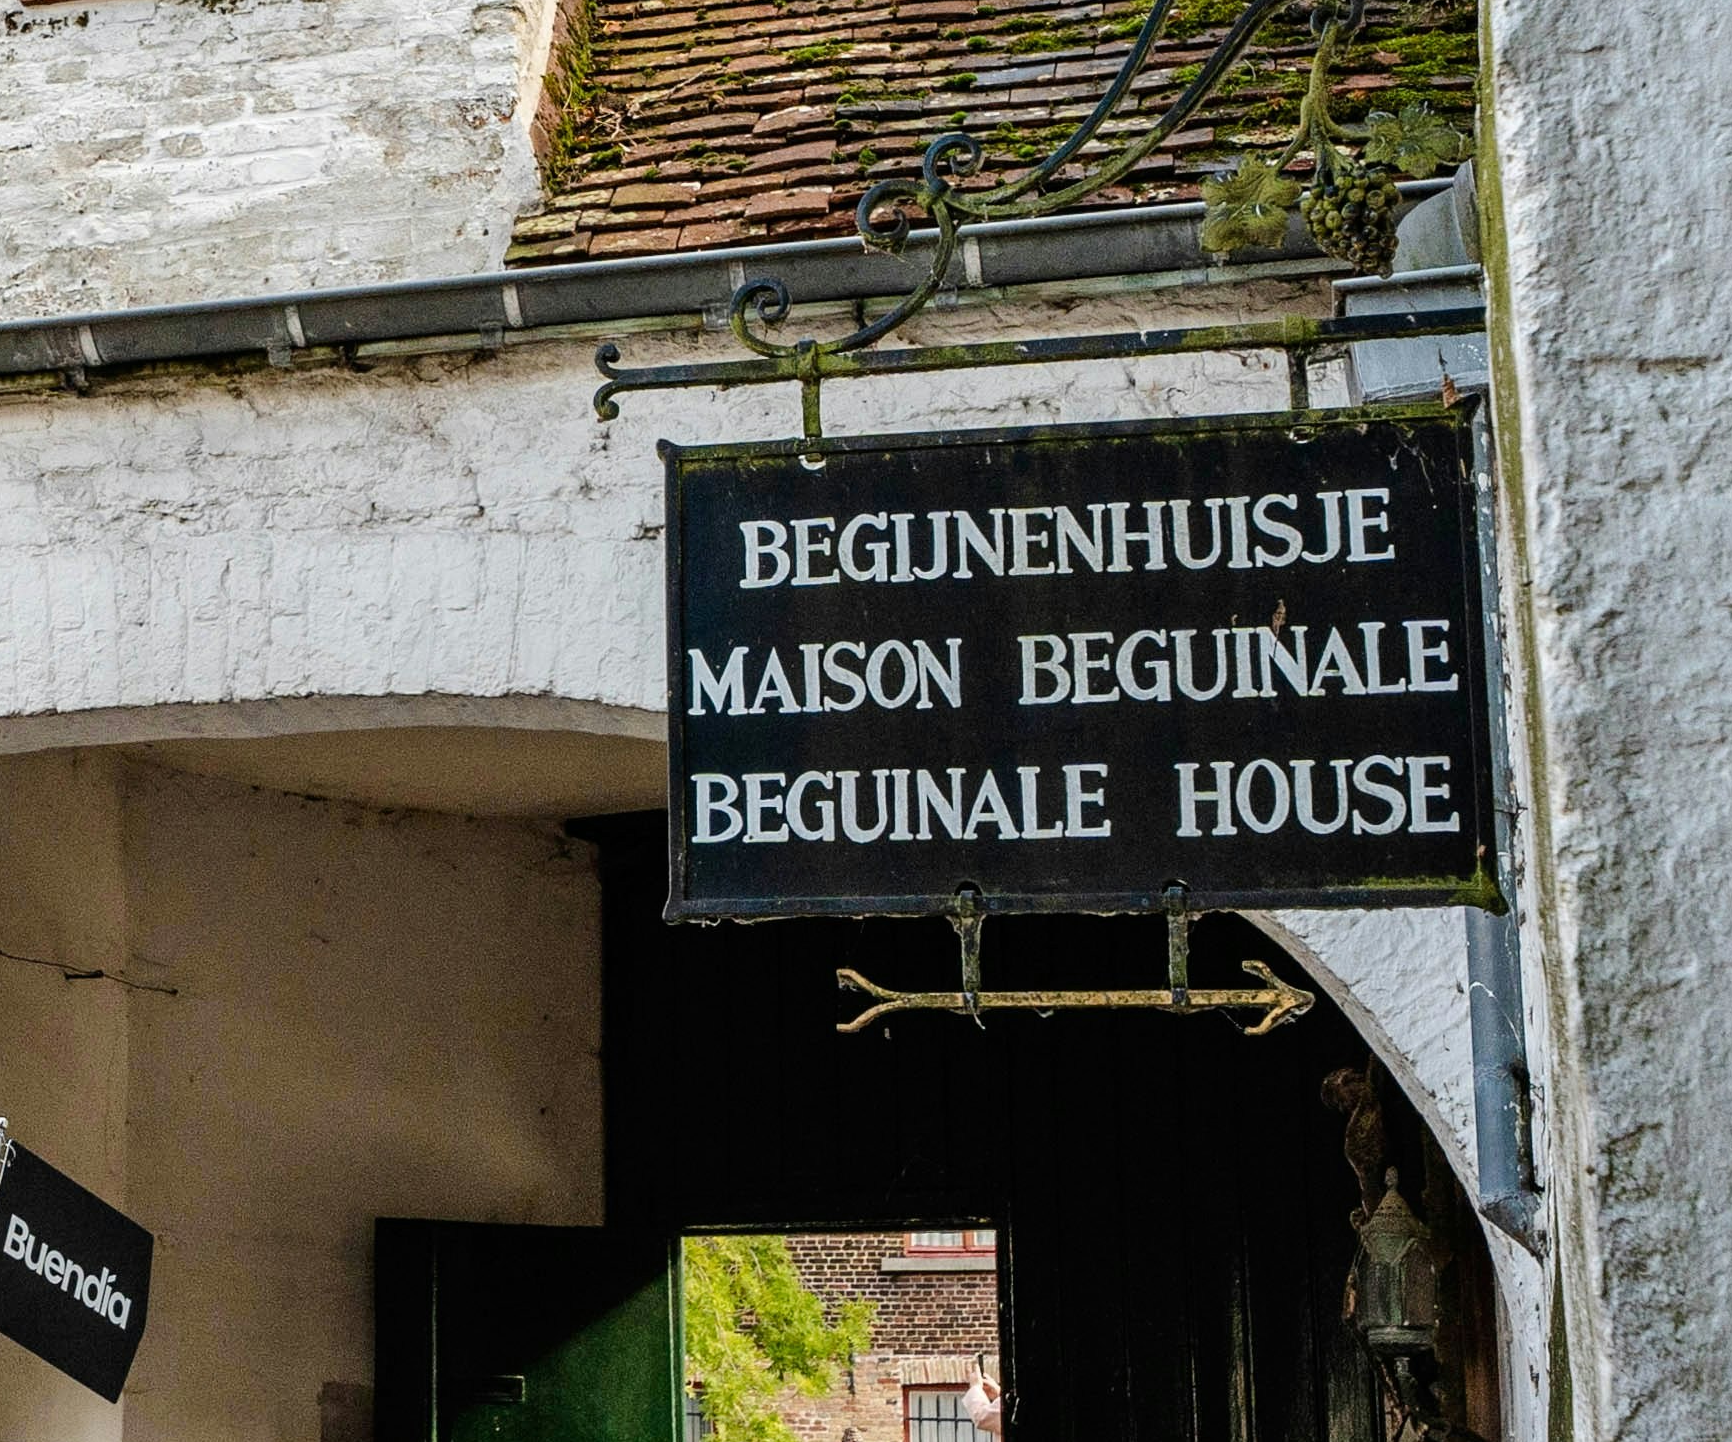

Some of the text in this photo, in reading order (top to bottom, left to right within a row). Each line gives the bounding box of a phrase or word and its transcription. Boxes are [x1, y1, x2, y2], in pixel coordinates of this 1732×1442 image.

[739, 488, 1395, 590] BEGIJNENHUISJE
[687, 619, 1459, 717] MAISON BEGUINALE
[691, 754, 1460, 845] BEGUINALE HOUSE
[3, 1214, 132, 1330] Buendía
